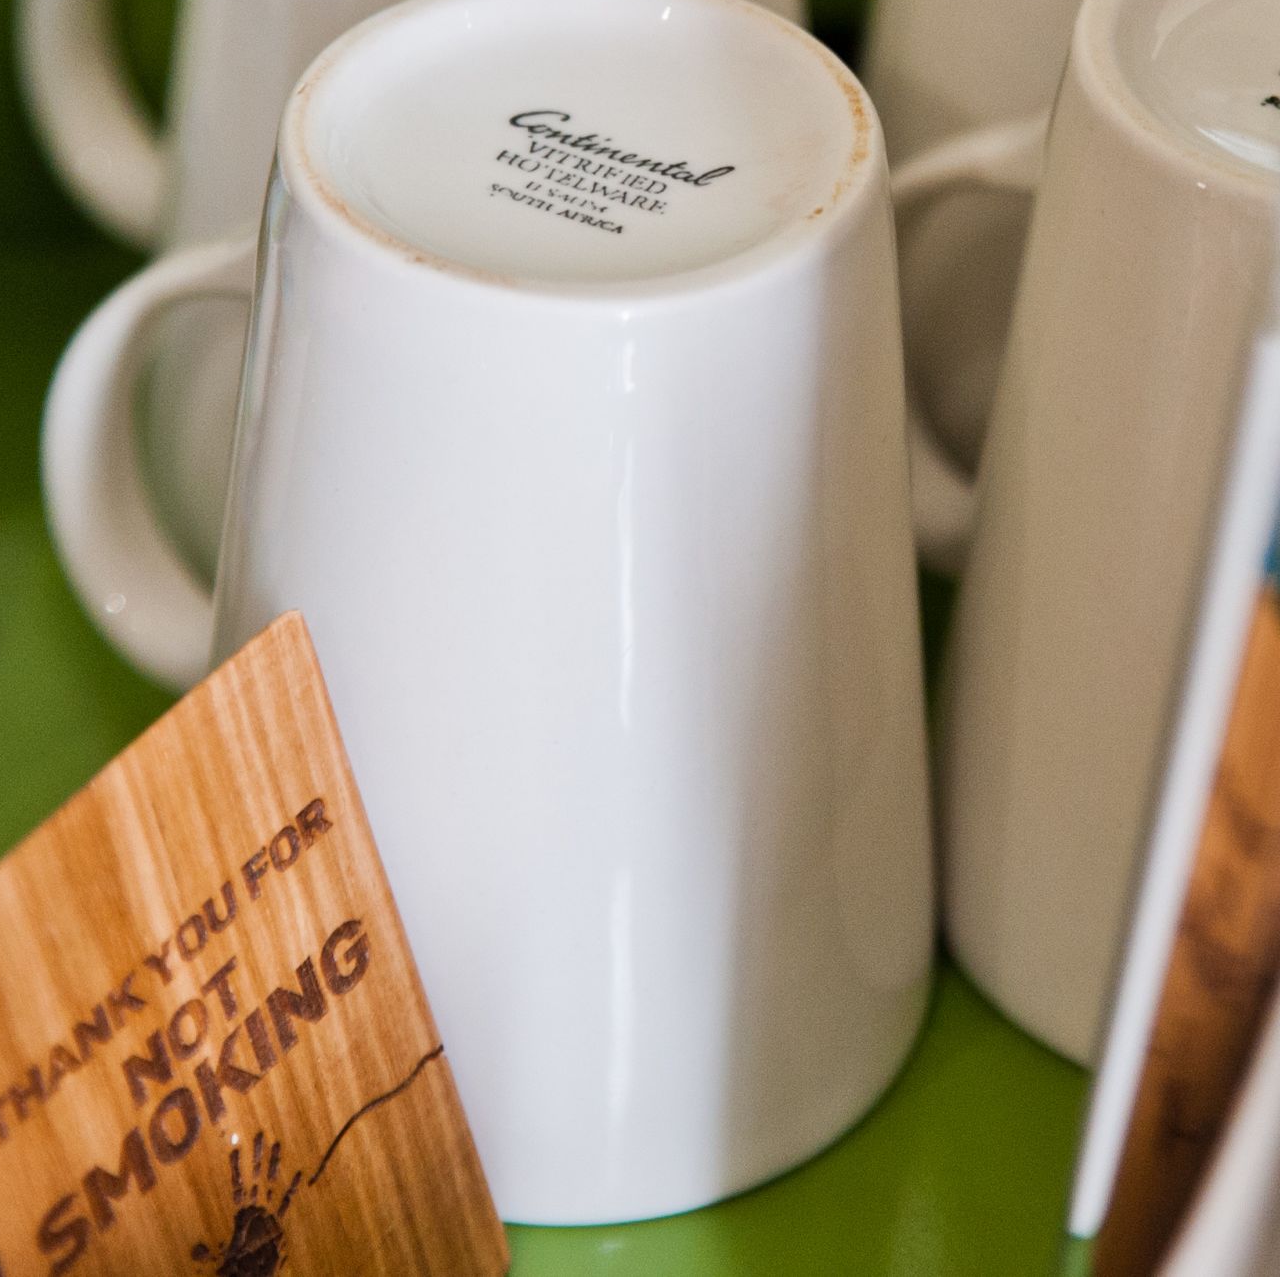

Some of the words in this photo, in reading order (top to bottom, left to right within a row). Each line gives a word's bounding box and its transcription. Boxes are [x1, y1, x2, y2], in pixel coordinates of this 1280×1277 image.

[495, 149, 668, 215] HOTELWARE
[509, 109, 736, 187] Continental
[526, 134, 669, 196] VITRIFIED
[489, 183, 554, 212] SOUTH
[556, 209, 624, 235] AFRICA
[143, 880, 238, 987] YOU
[241, 796, 334, 902] FOR
[122, 956, 238, 1108] NOT
[36, 918, 372, 1277] SMOKING
